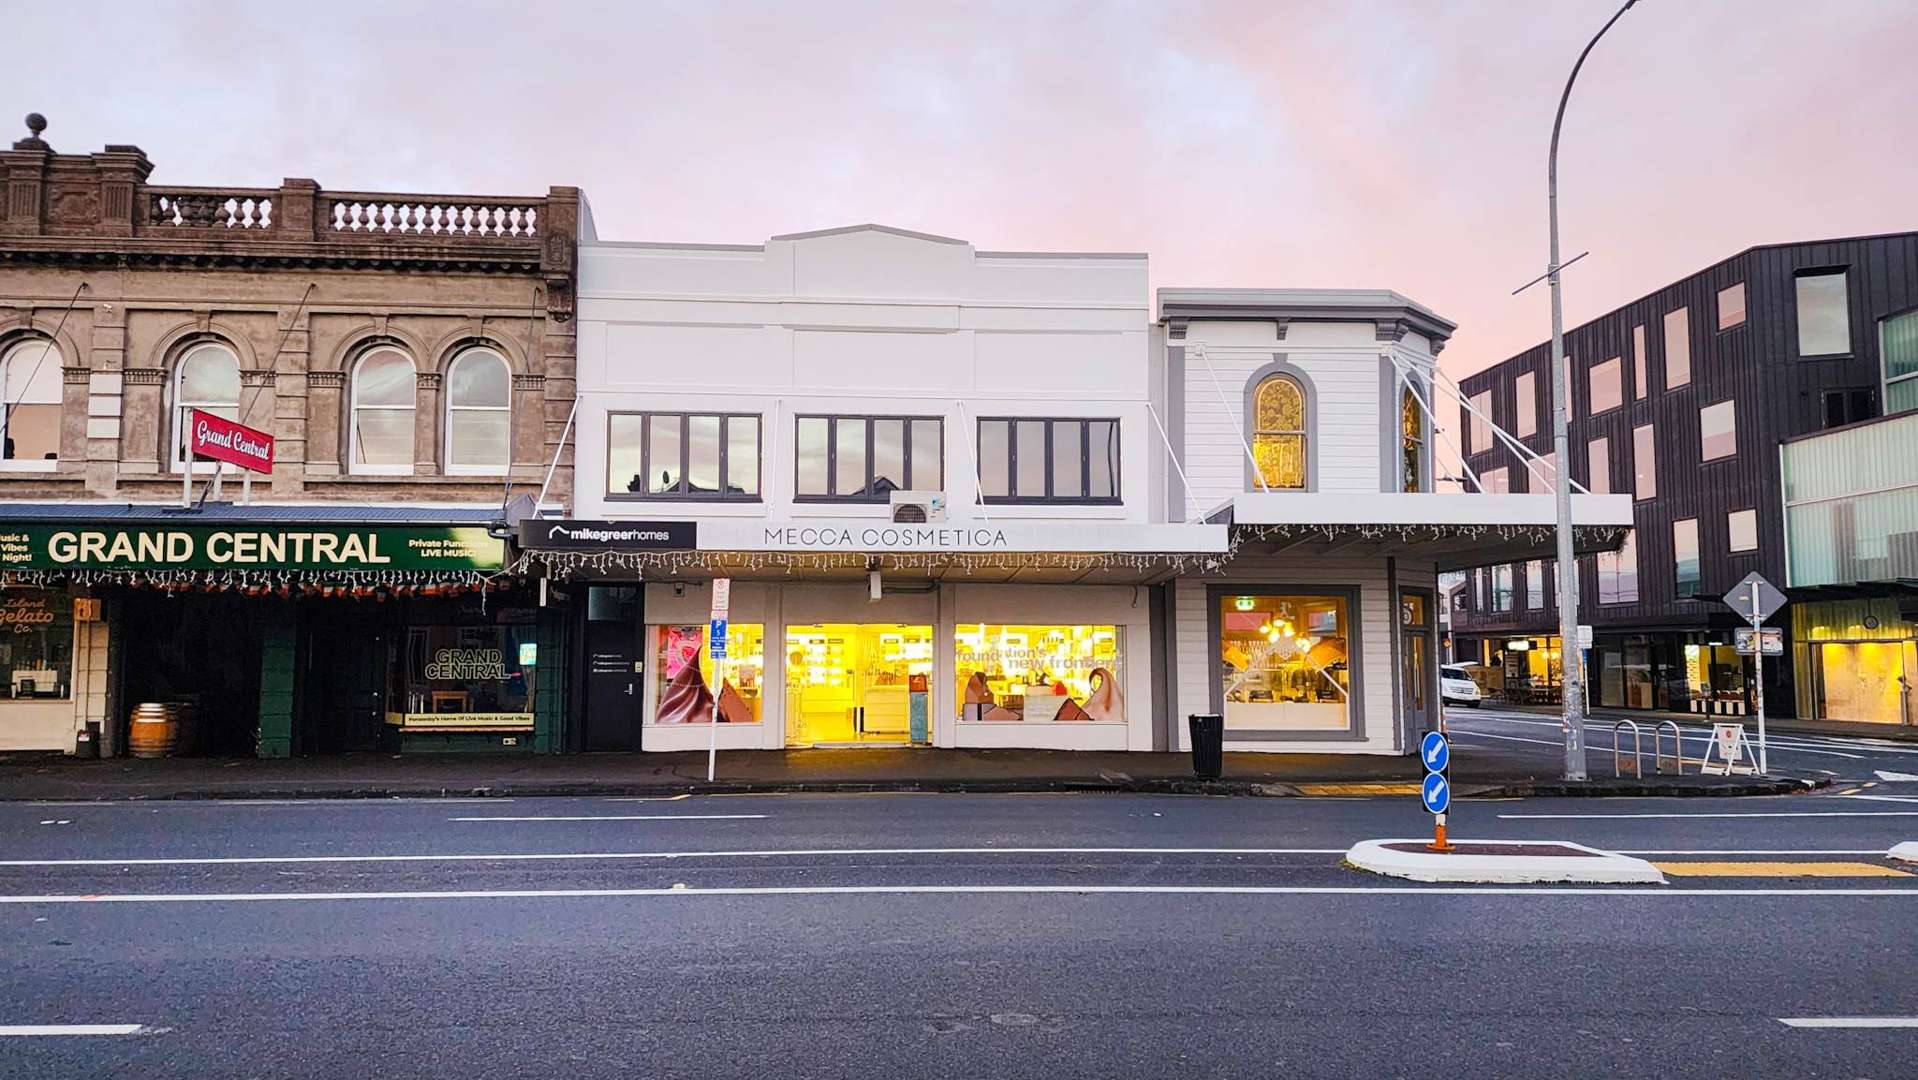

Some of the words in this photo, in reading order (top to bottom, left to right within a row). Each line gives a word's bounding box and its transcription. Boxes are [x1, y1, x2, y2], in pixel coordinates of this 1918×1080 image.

[197, 420, 232, 446] Grand
[233, 432, 270, 460] Central
[0, 533, 20, 542] usic
[22, 534, 30, 542] &
[570, 528, 669, 542] mikegreerhomes
[764, 528, 853, 545] MECCA
[862, 529, 1007, 546] COSMETICA
[0, 543, 28, 552] Vibes
[48, 531, 194, 563] GRAND
[206, 531, 391, 563] CENTRAL
[408, 539, 441, 547] Private
[2, 553, 32, 563] Night!
[421, 549, 441, 557] LIVE
[716, 620, 722, 629] P
[435, 649, 502, 664] GRAND
[425, 662, 511, 679] CENTRAL
[1008, 657, 1045, 671] new
